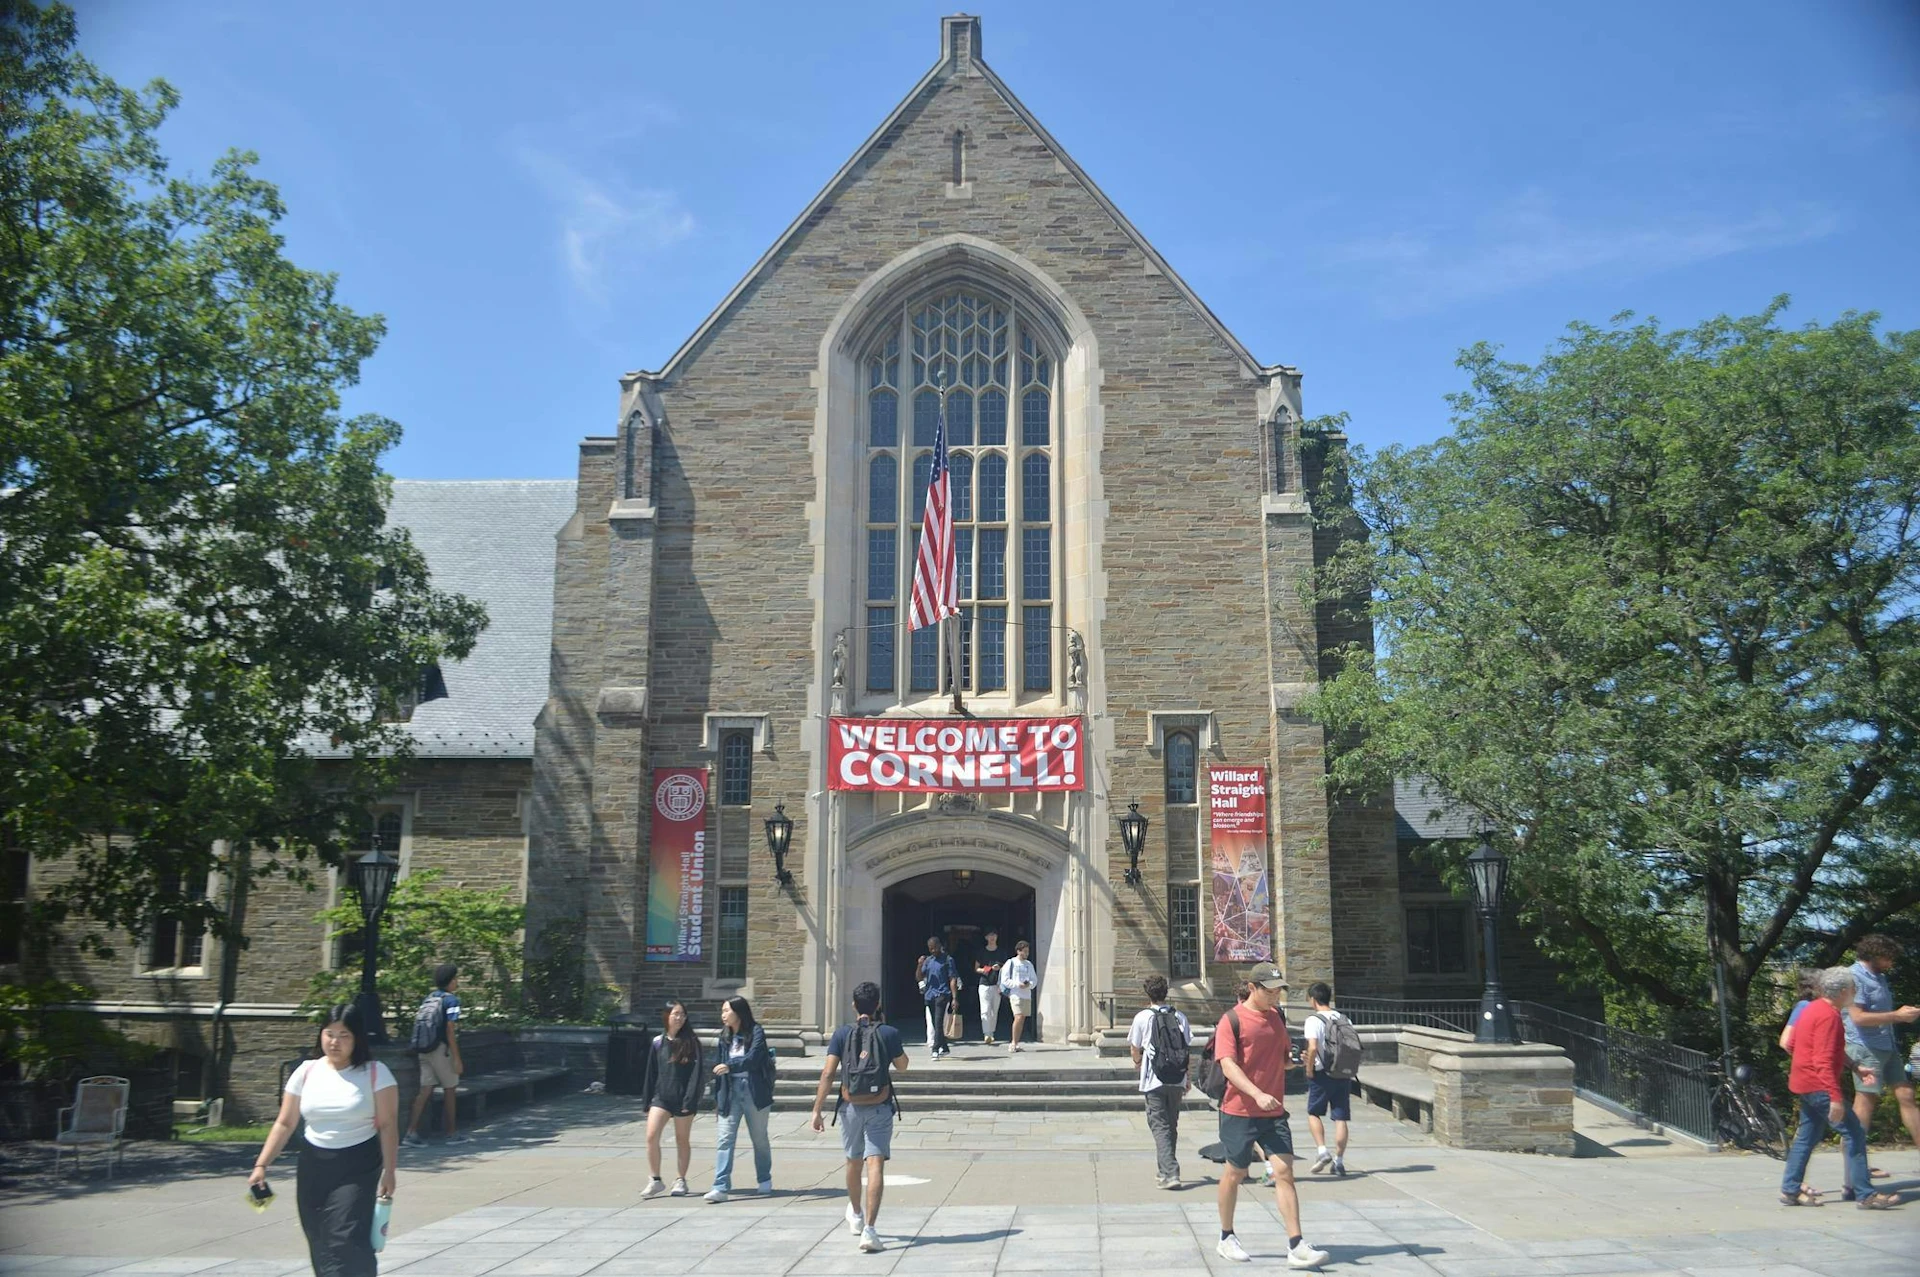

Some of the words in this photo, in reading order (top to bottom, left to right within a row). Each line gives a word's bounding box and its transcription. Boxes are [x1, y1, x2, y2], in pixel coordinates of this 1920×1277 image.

[840, 724, 1019, 752] WELCOME
[1027, 724, 1077, 751] TO
[840, 750, 1076, 787] CORNELL!
[1210, 770, 1258, 782] Willard
[1211, 783, 1265, 798] Straight
[1211, 797, 1238, 808] Hall
[681, 851, 691, 872] Hall
[690, 830, 705, 882] Union
[680, 875, 690, 915] Straight
[678, 918, 689, 955] Willard
[687, 885, 703, 956] Student
